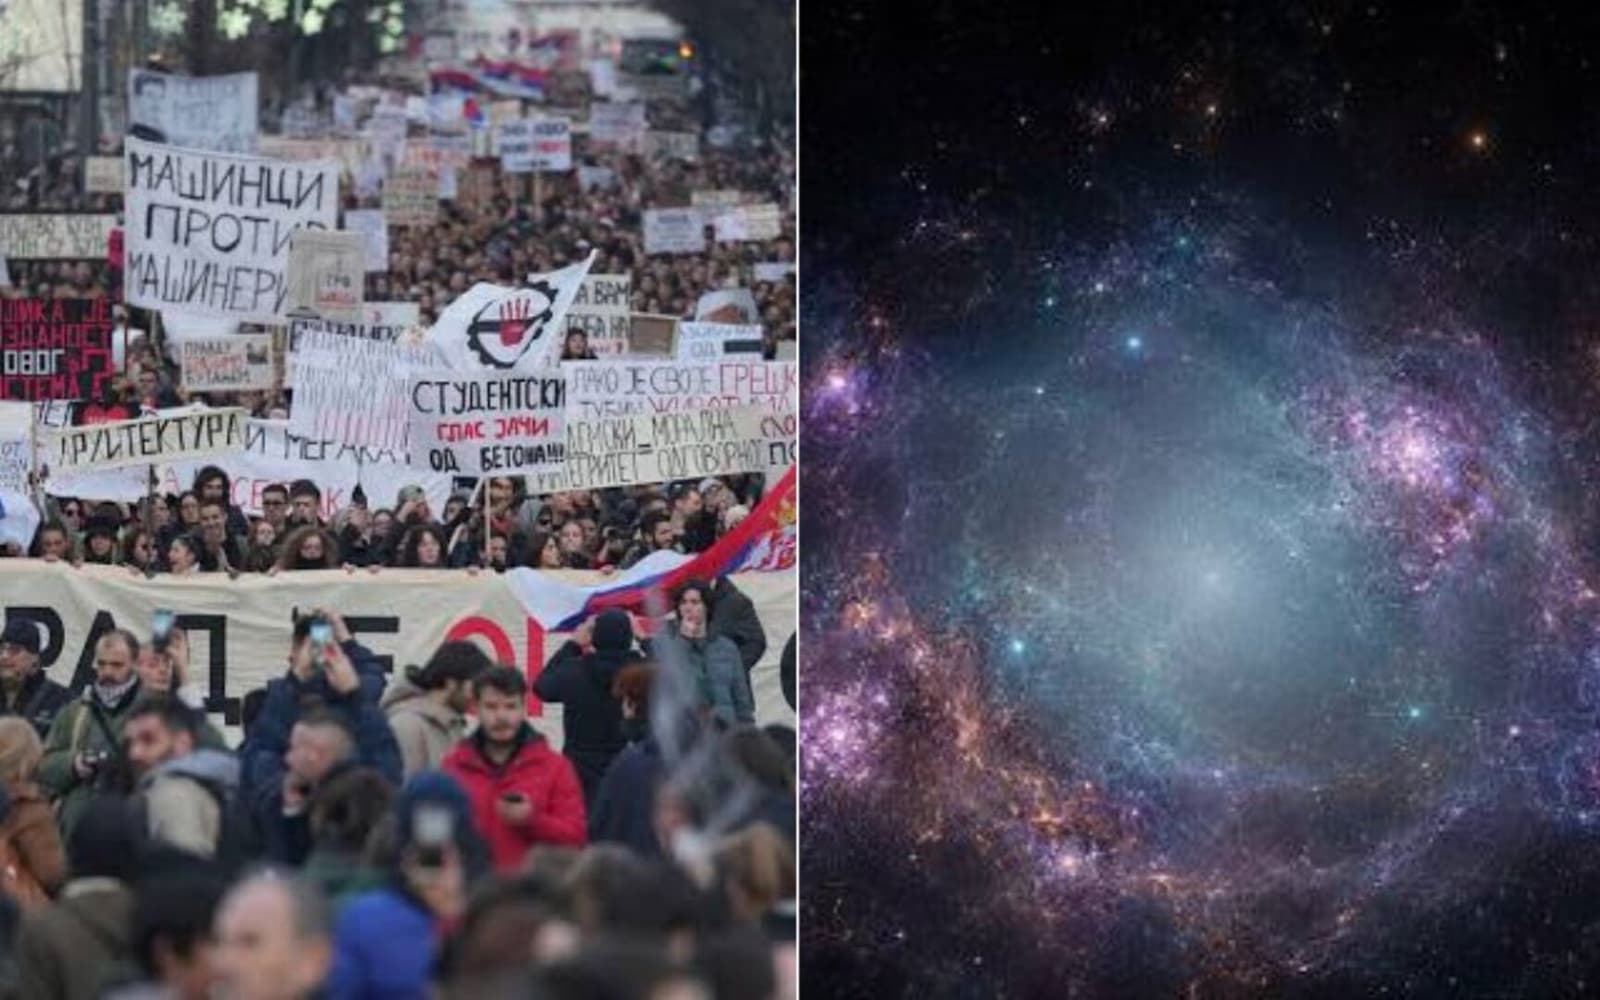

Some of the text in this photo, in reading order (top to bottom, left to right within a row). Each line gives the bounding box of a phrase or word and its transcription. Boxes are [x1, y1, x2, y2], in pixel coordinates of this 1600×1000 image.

[129, 152, 323, 210] МАШИНЦИ
[145, 203, 326, 256] ПРОТИ
[4, 350, 65, 375] ОВОГ
[412, 376, 565, 414] СТУДЕНТСКИ
[437, 415, 549, 442] ГЛАС ЈАЧИ
[429, 447, 460, 473] ОД
